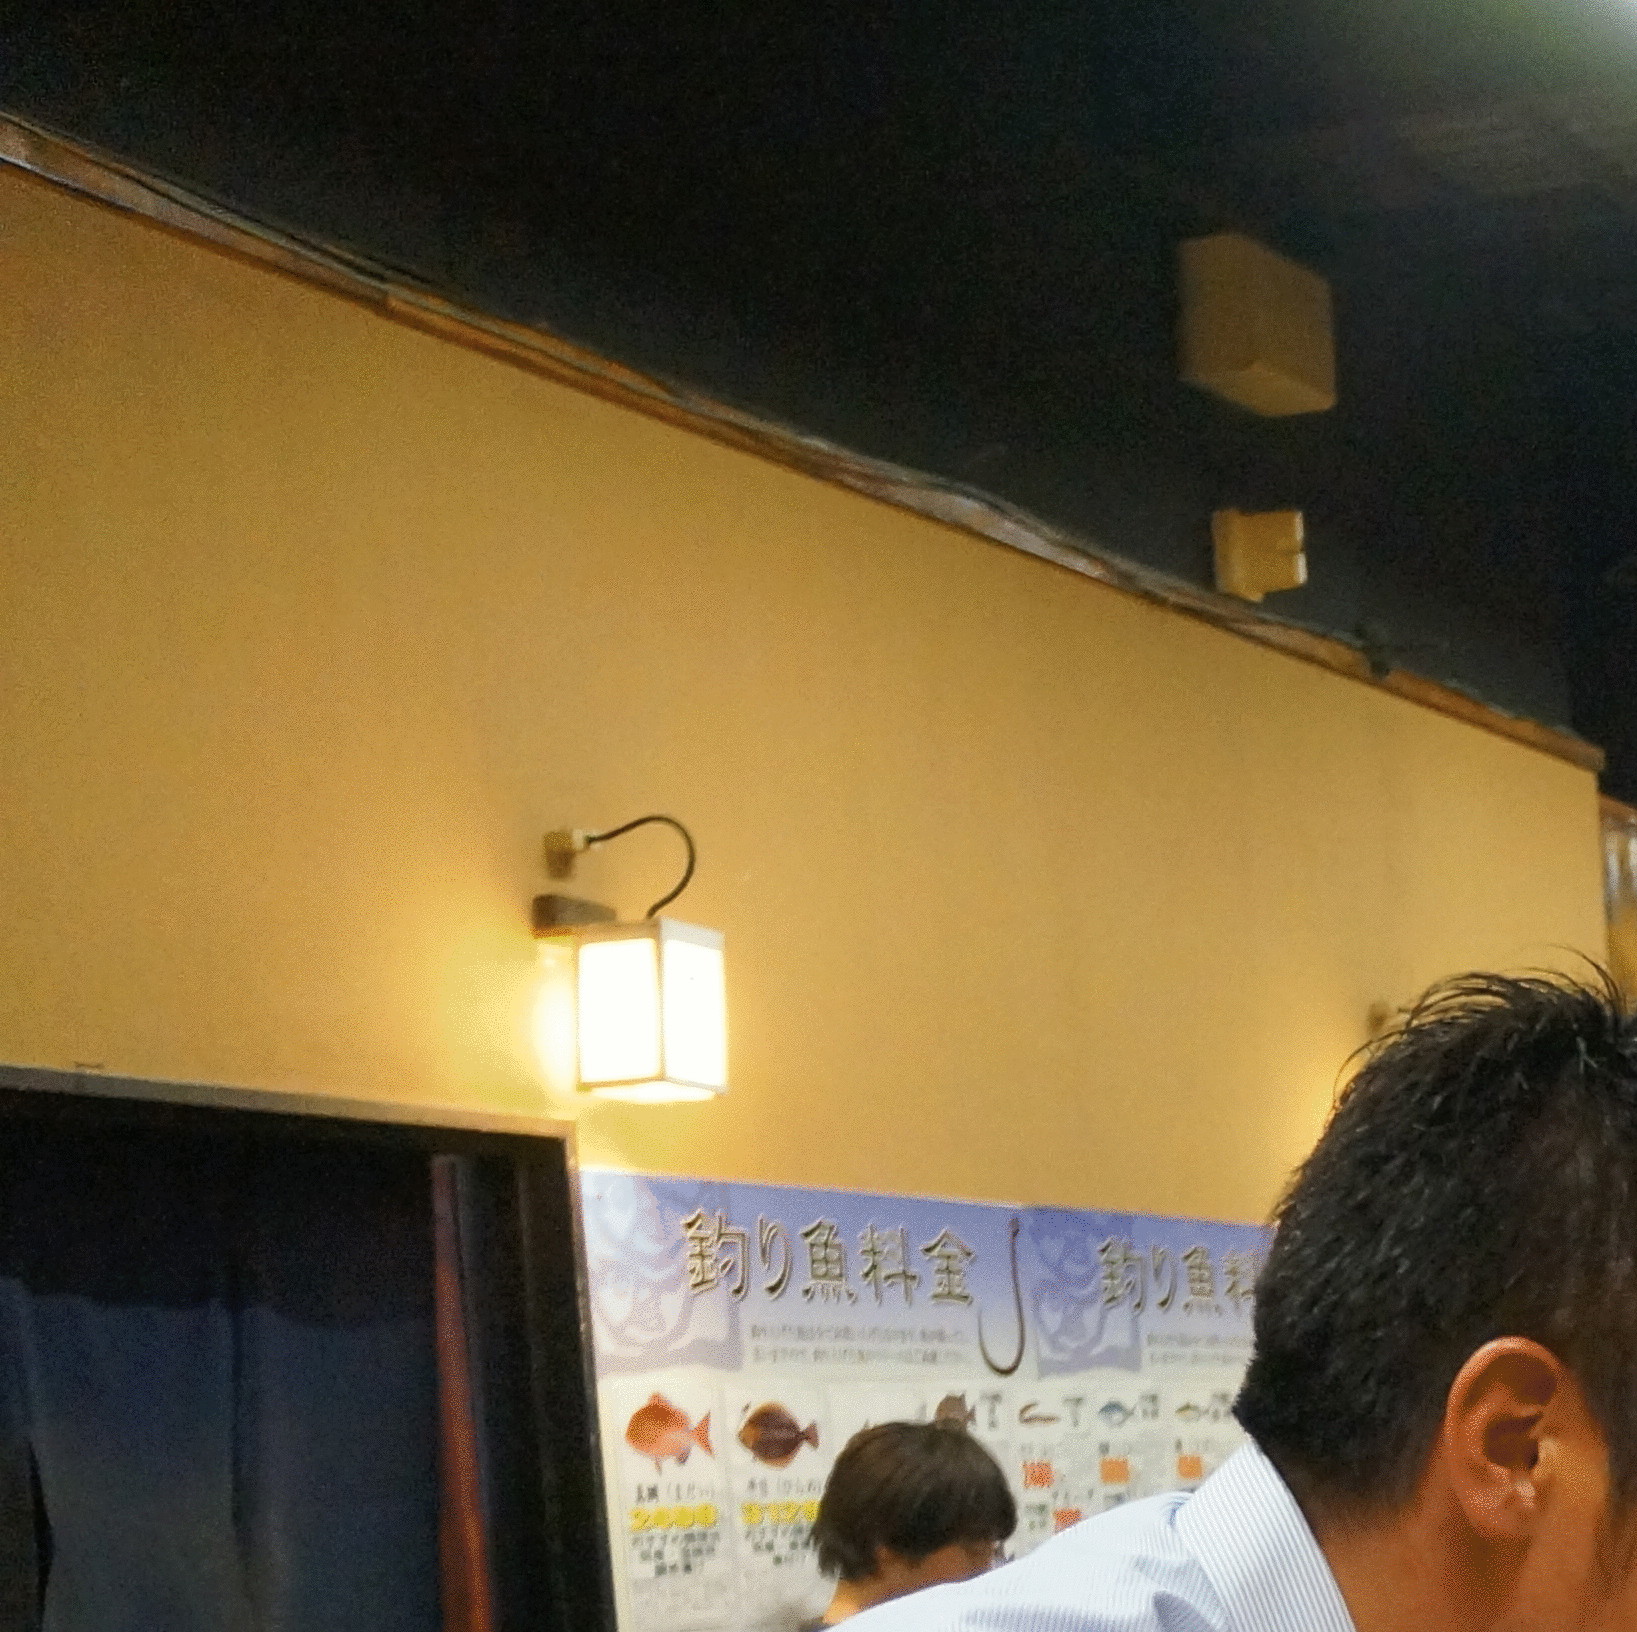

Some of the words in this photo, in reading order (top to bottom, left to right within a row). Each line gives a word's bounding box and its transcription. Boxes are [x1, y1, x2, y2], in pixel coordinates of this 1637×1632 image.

[681, 1207, 976, 1306] 釣り魚料金
